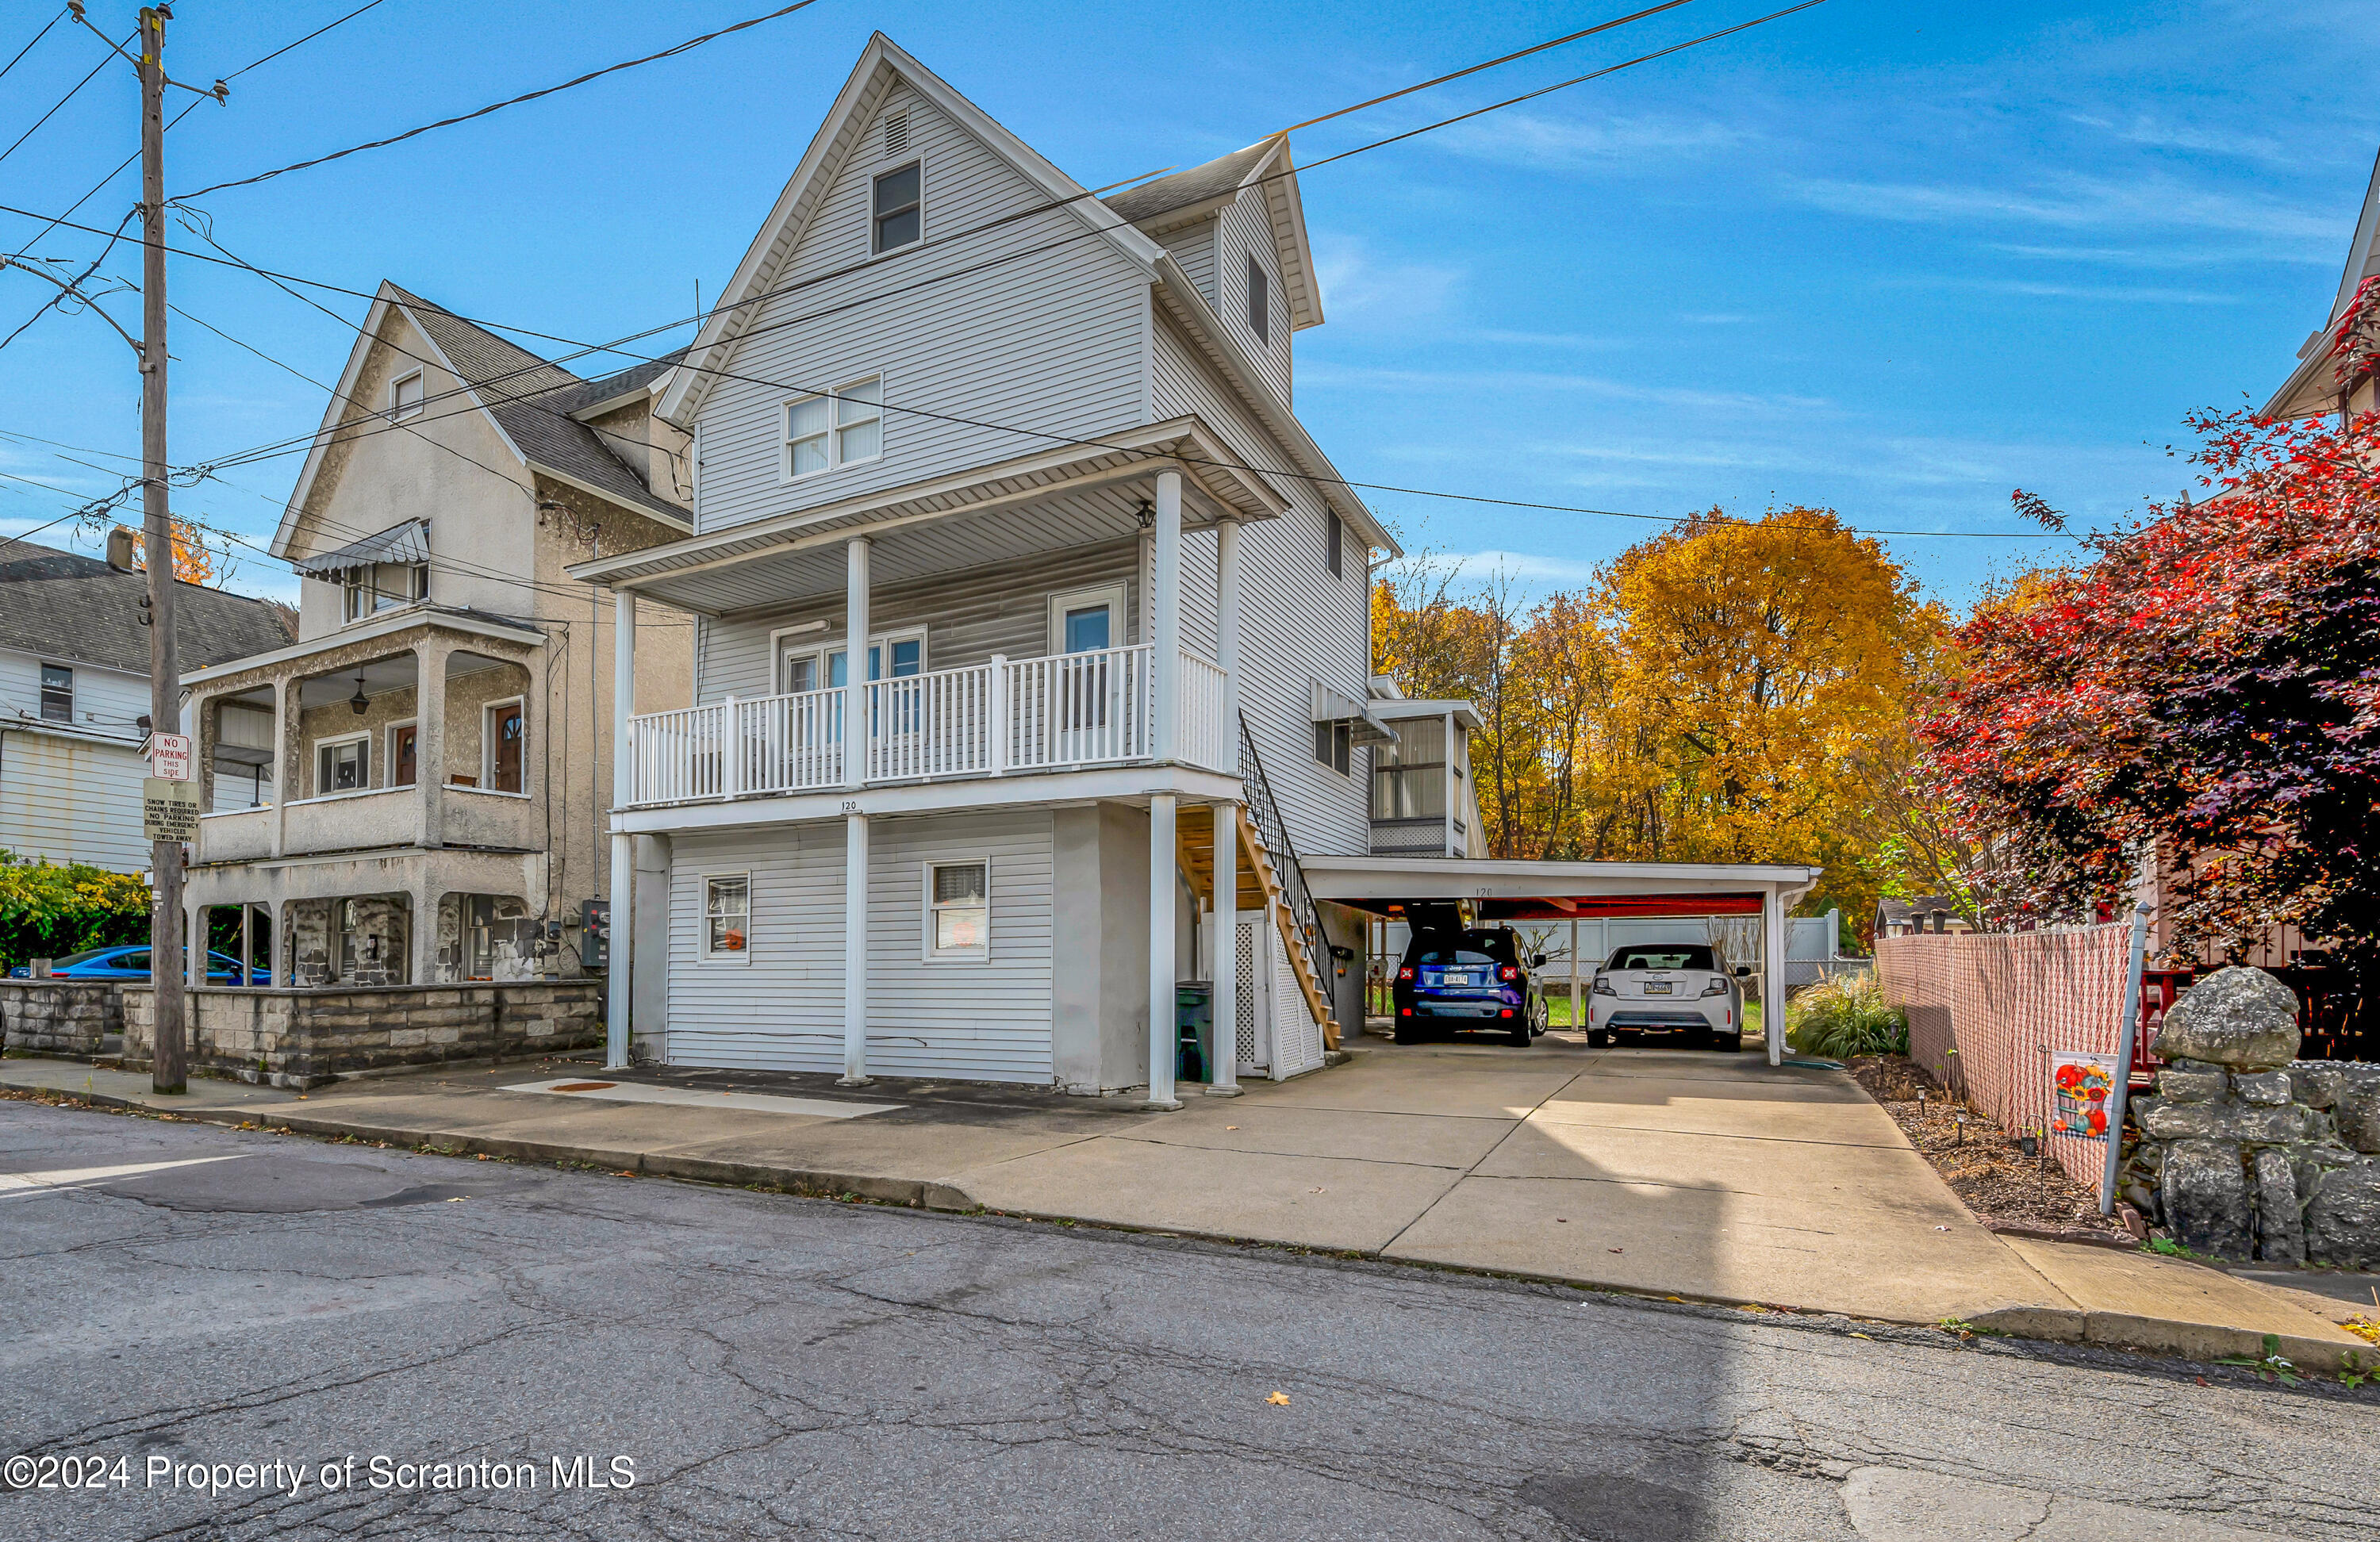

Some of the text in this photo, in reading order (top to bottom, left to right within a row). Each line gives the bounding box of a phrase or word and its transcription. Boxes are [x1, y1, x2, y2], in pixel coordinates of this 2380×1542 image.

[164, 738, 178, 747] NO
[155, 749, 186, 760] PARKING
[843, 801, 856, 811] 120
